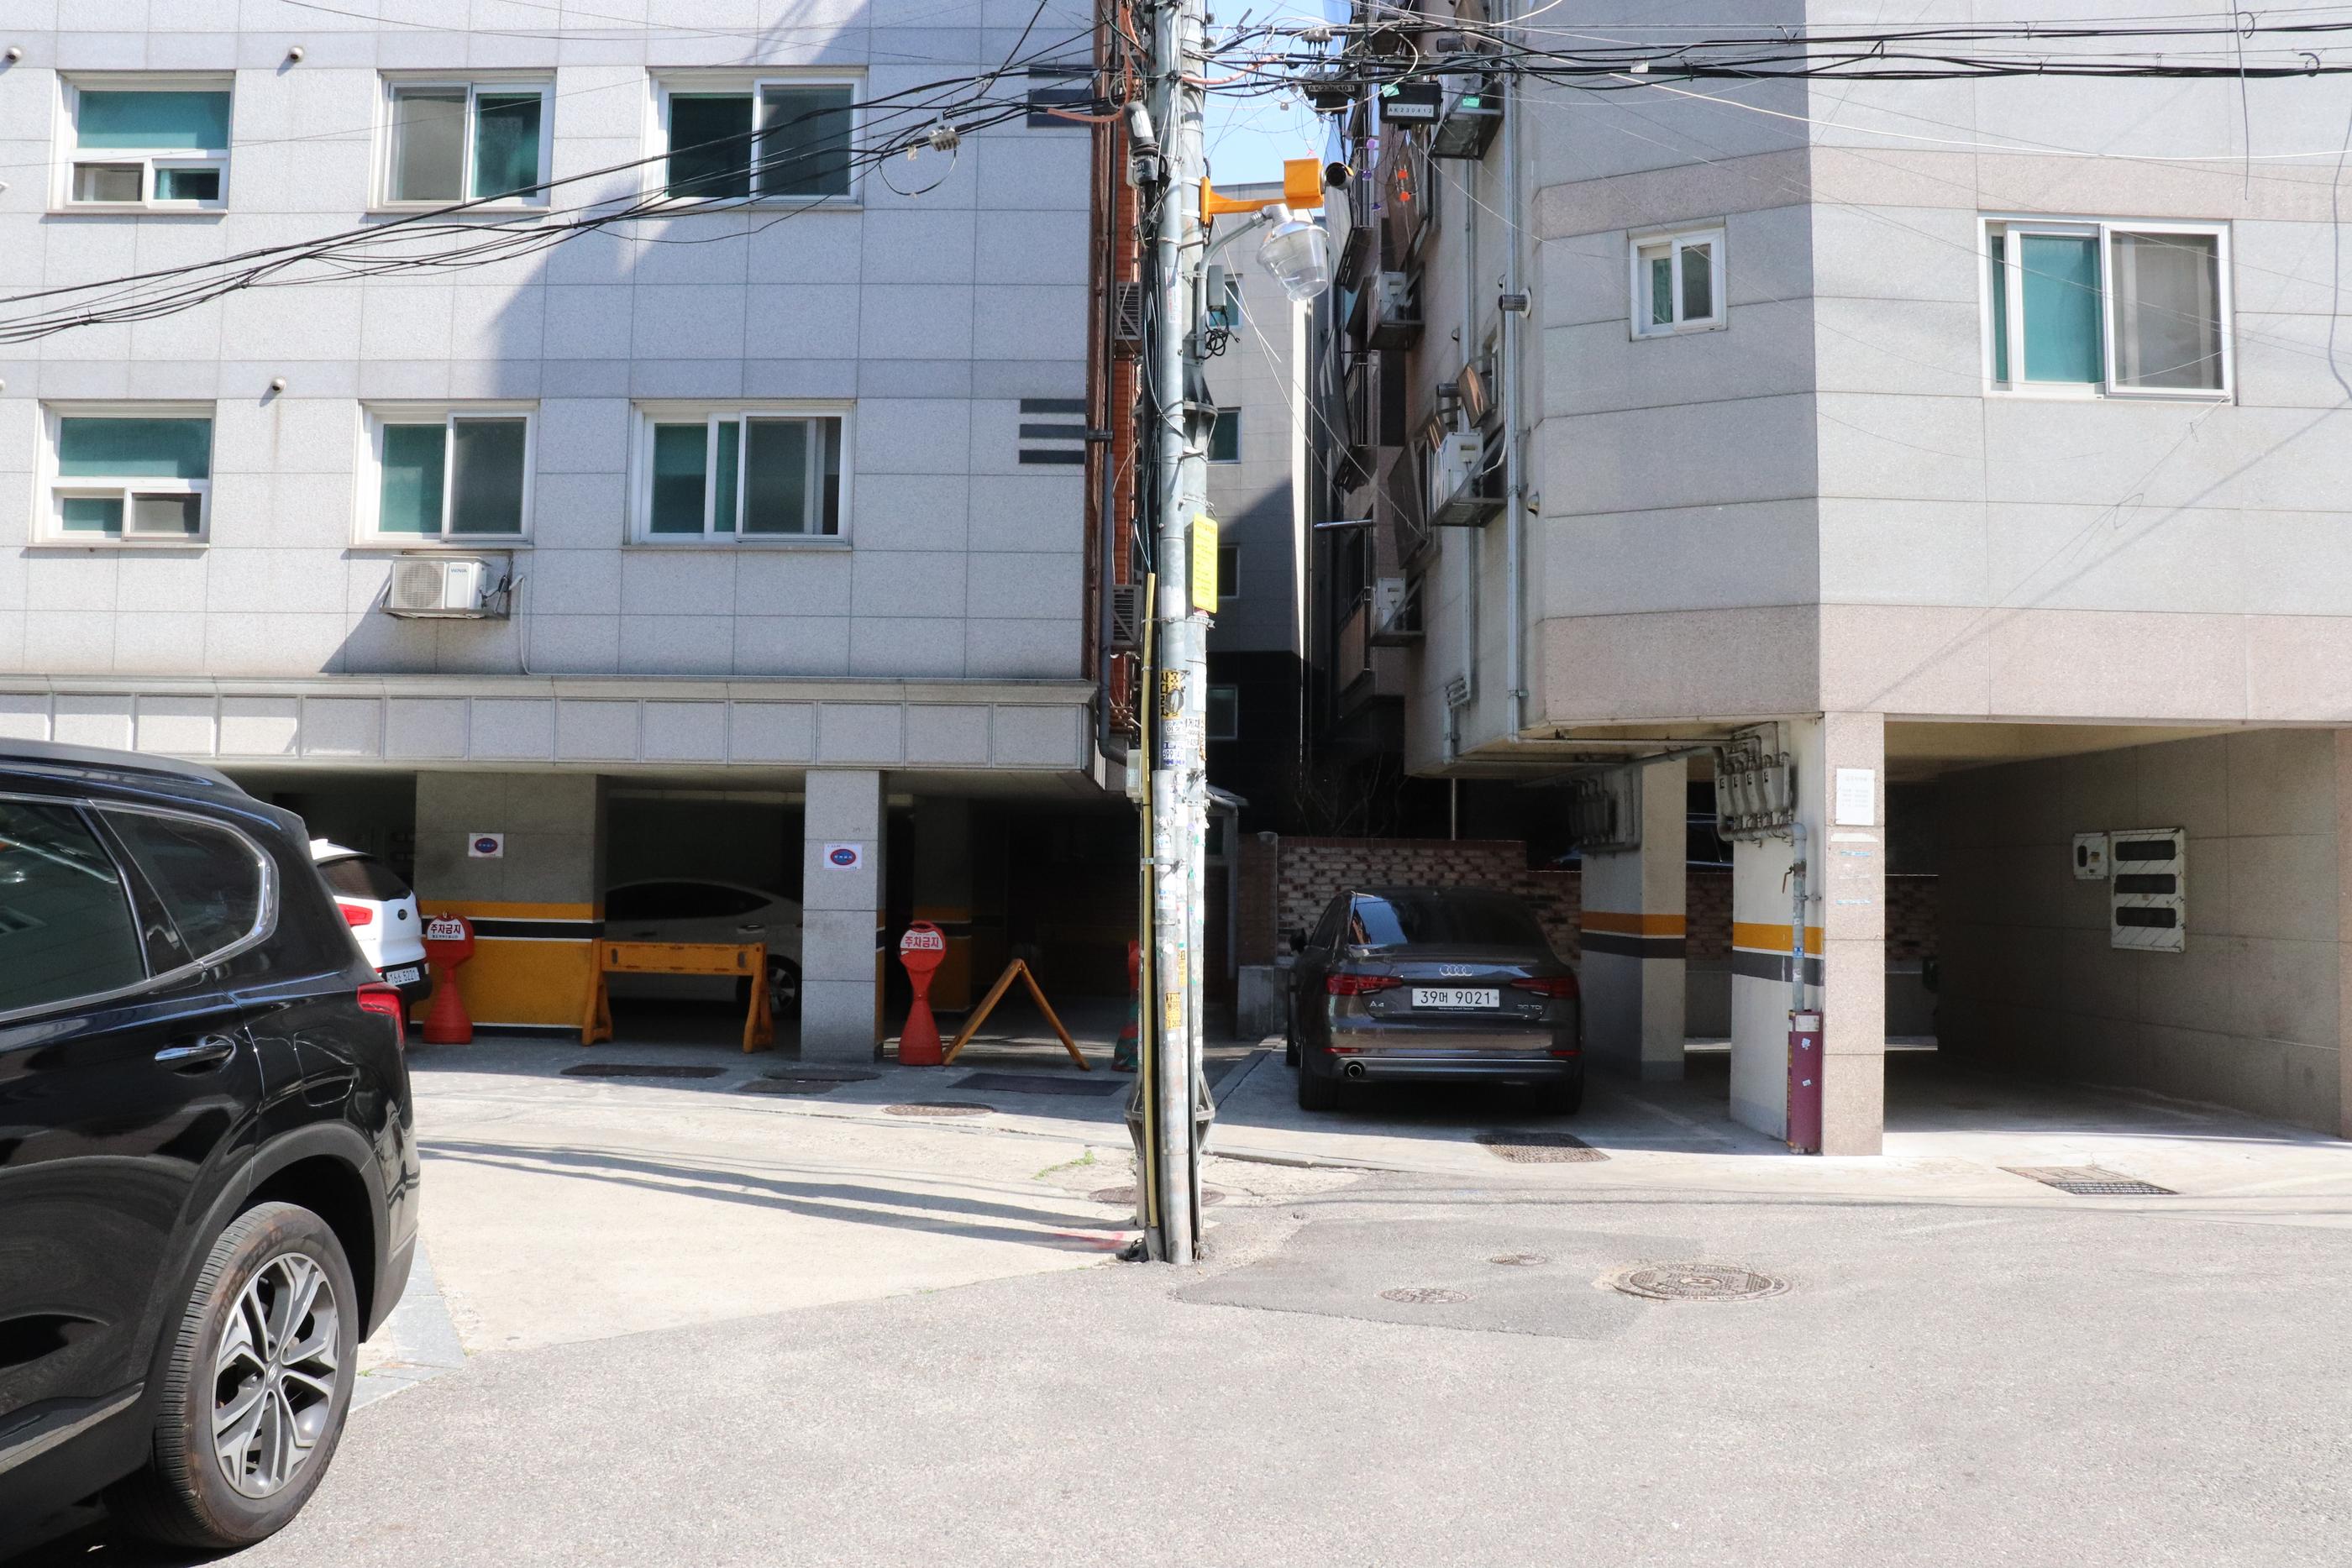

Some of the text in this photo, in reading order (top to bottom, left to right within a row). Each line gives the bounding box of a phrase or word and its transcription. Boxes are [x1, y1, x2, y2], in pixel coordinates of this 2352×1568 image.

[430, 923, 461, 935] 주차금지
[905, 936, 939, 948] 주차금지
[1420, 990, 1491, 1005] 39머 9021
